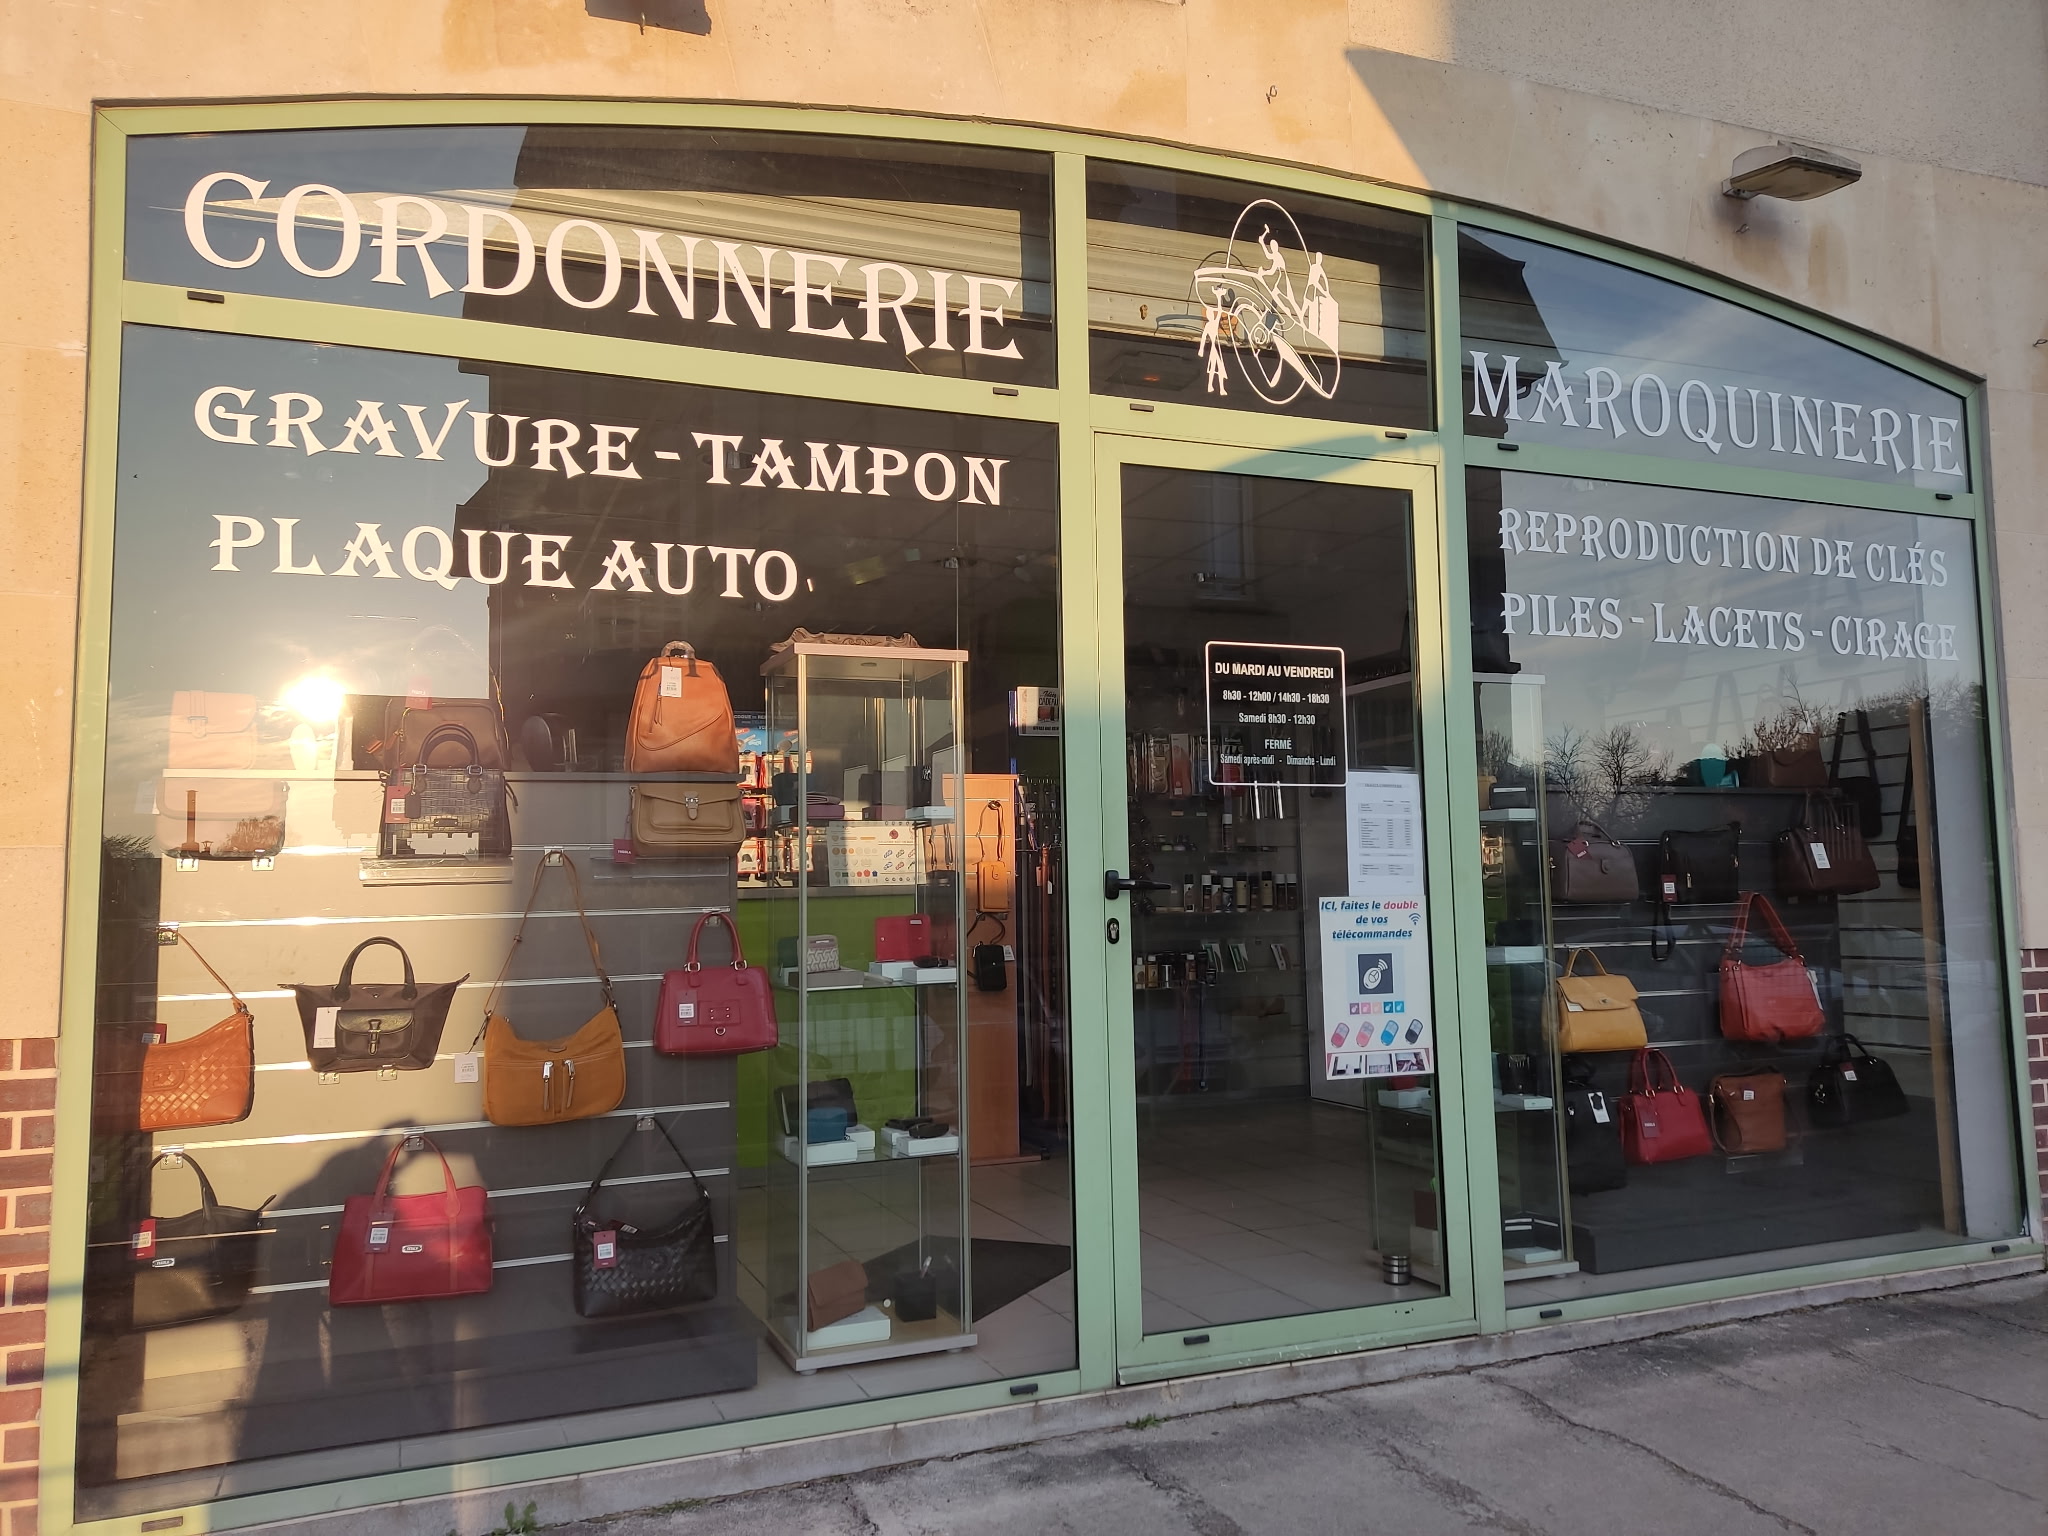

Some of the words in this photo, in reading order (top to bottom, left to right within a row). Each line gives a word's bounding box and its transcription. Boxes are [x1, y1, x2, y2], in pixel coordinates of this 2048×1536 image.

[184, 171, 1024, 360] CORDONNERIE
[1469, 350, 1964, 477] MAROQUINERIE
[194, 385, 642, 480] GRAVURE
[691, 432, 1011, 506] TAMPON
[1498, 507, 1802, 573] REPRODUCTION
[1811, 537, 1858, 579] DE
[1866, 541, 1949, 588] CLÉS
[209, 514, 576, 592] PLAQUE
[590, 540, 799, 602] AUTO
[1500, 592, 1623, 640] PILES
[1651, 602, 1804, 652] LACETS
[1830, 615, 1960, 661] CIRAGE
[1215, 662, 1230, 675] DU
[1232, 663, 1266, 677] MARDI
[1267, 665, 1282, 677] AU
[1283, 666, 1334, 679] VENDREDI
[1222, 690, 1242, 701] 8h30
[1248, 691, 1272, 702] 12h00
[1278, 692, 1301, 703] 14h30
[1307, 693, 1330, 704] 18h30
[1239, 712, 1267, 724] Samedi
[1268, 713, 1287, 724] 8h30
[1293, 714, 1316, 725] 12h30
[1264, 737, 1292, 750] FERMÉ
[1220, 753, 1243, 764] Samedi
[1244, 754, 1275, 766] après-midi
[1287, 755, 1315, 766] Dimanche
[1320, 756, 1336, 766] Lundi
[1320, 901, 1337, 911] ICI,
[1341, 901, 1369, 910] faites
[1372, 900, 1381, 910] le
[1383, 901, 1418, 910] double
[1355, 915, 1369, 924] de
[1371, 916, 1388, 924] vos
[1332, 928, 1413, 939] télécommandes
